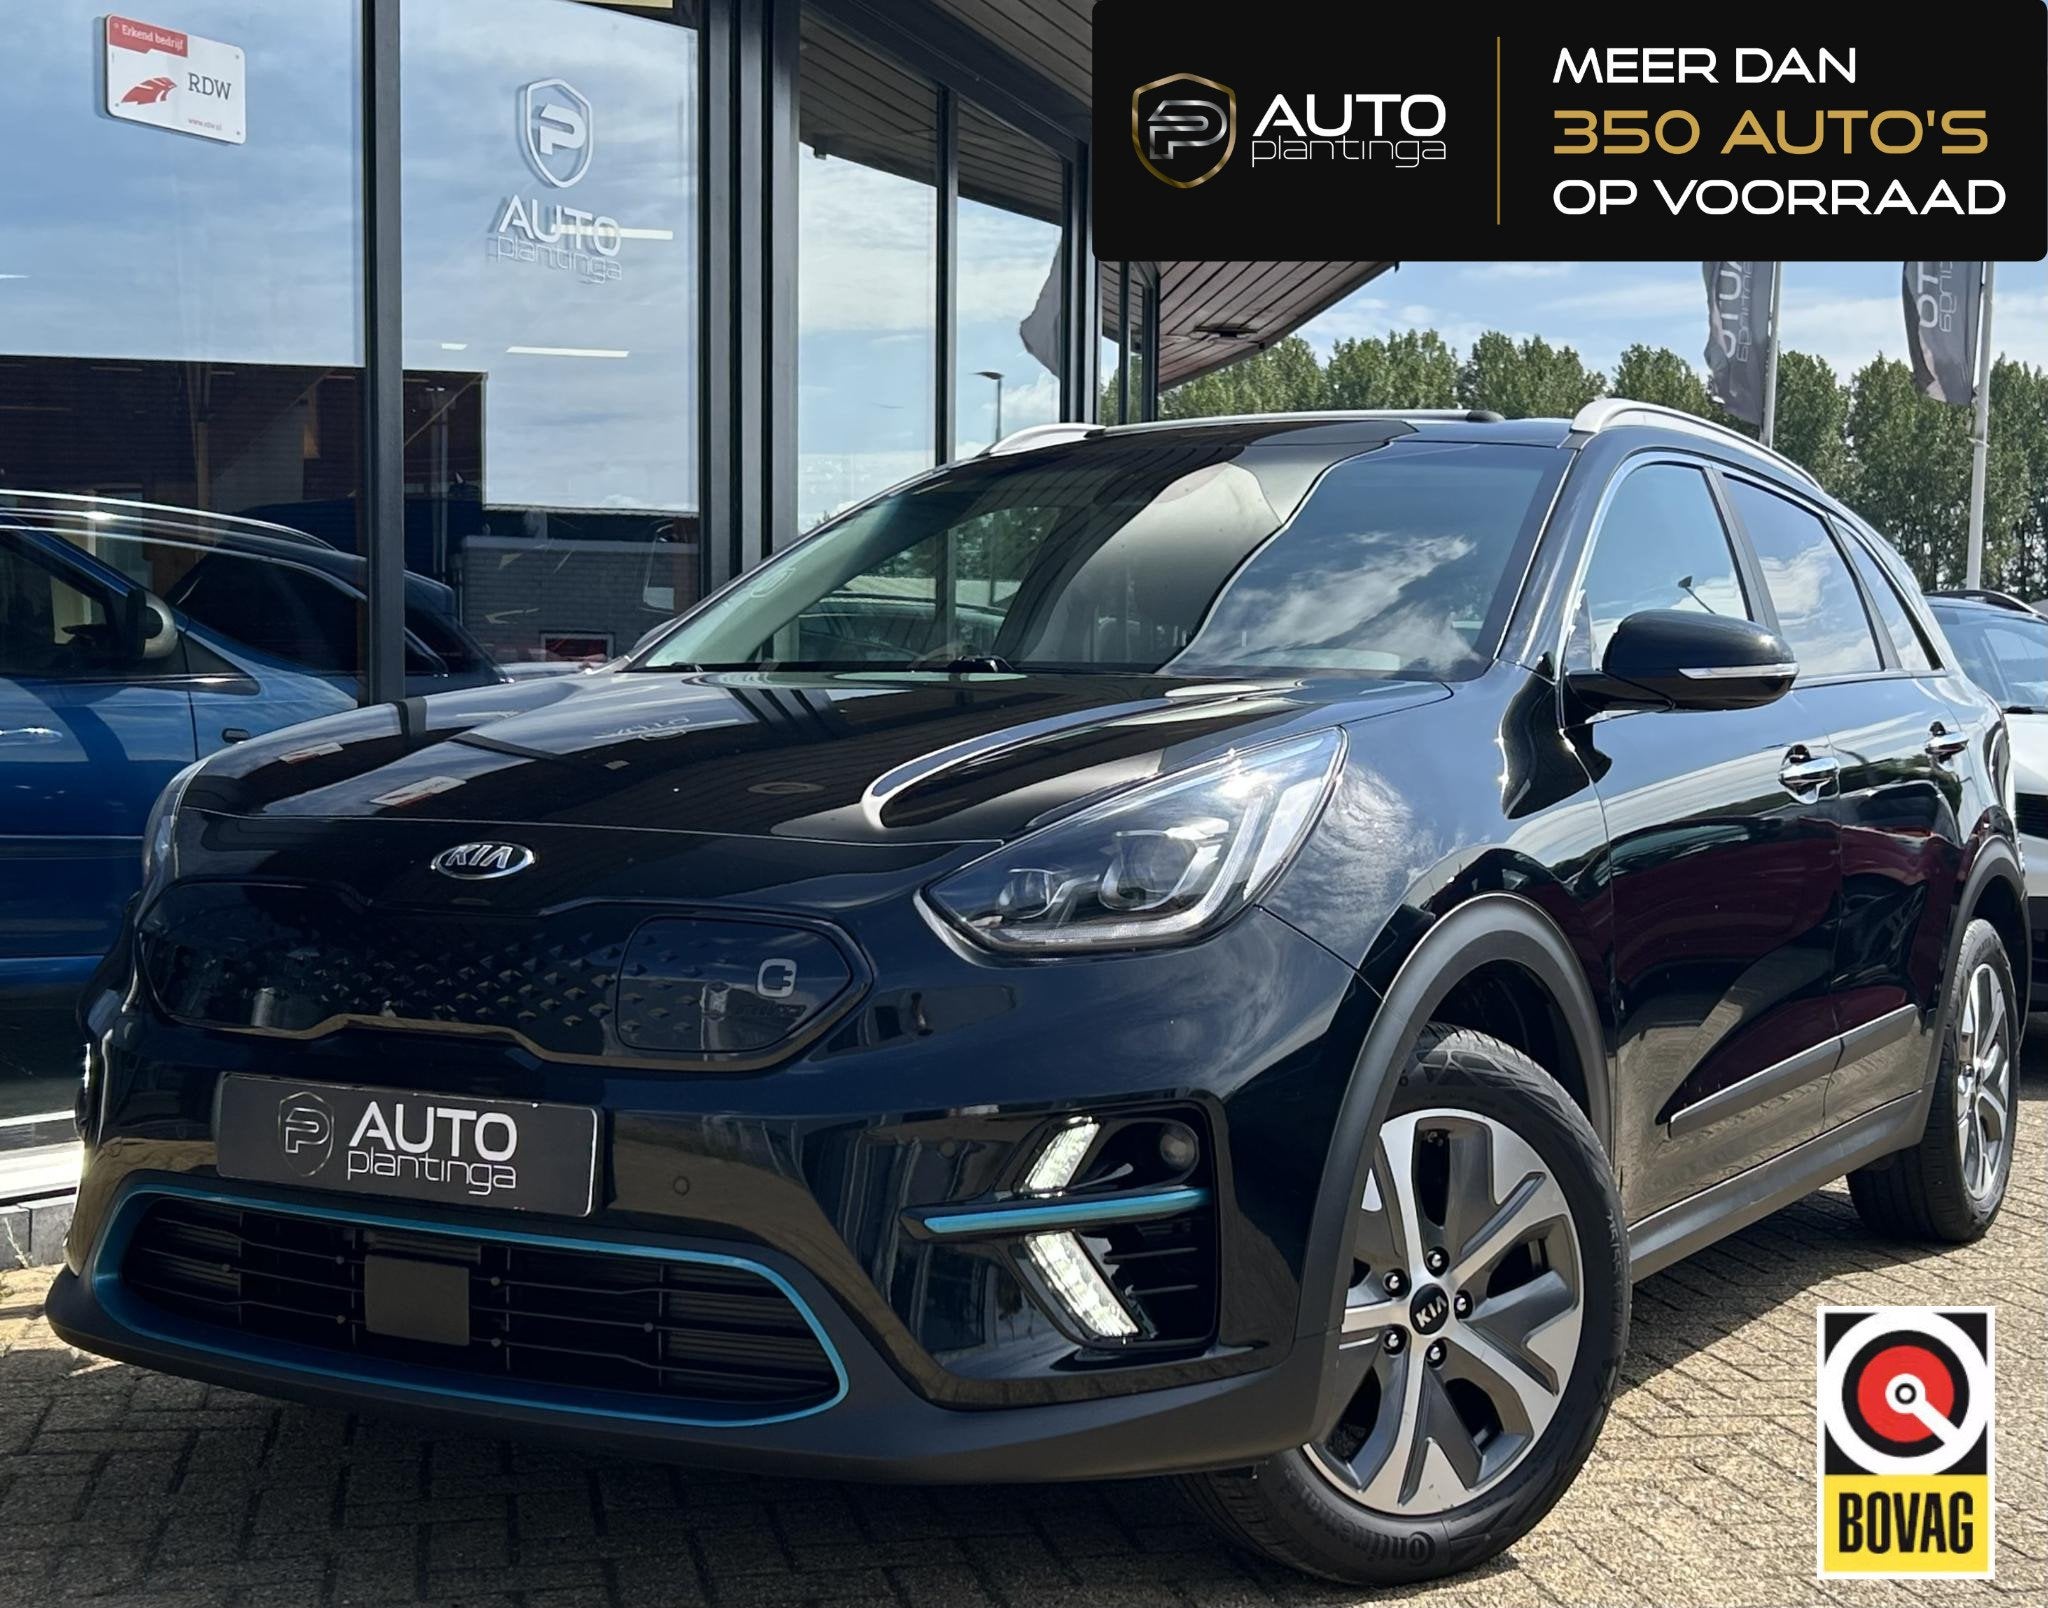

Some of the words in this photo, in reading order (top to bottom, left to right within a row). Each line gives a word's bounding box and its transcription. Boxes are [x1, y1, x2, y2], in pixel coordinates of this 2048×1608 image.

[121, 23, 154, 42] Erkend
[155, 32, 184, 51] bedrijf
[188, 72, 232, 101] RDW
[498, 194, 621, 257] AUTO
[497, 235, 623, 284] plantinga
[445, 844, 514, 869] KIA
[349, 1101, 518, 1161] AUTO
[347, 1147, 517, 1195] plantinga
[1415, 1296, 1448, 1328] KIA
